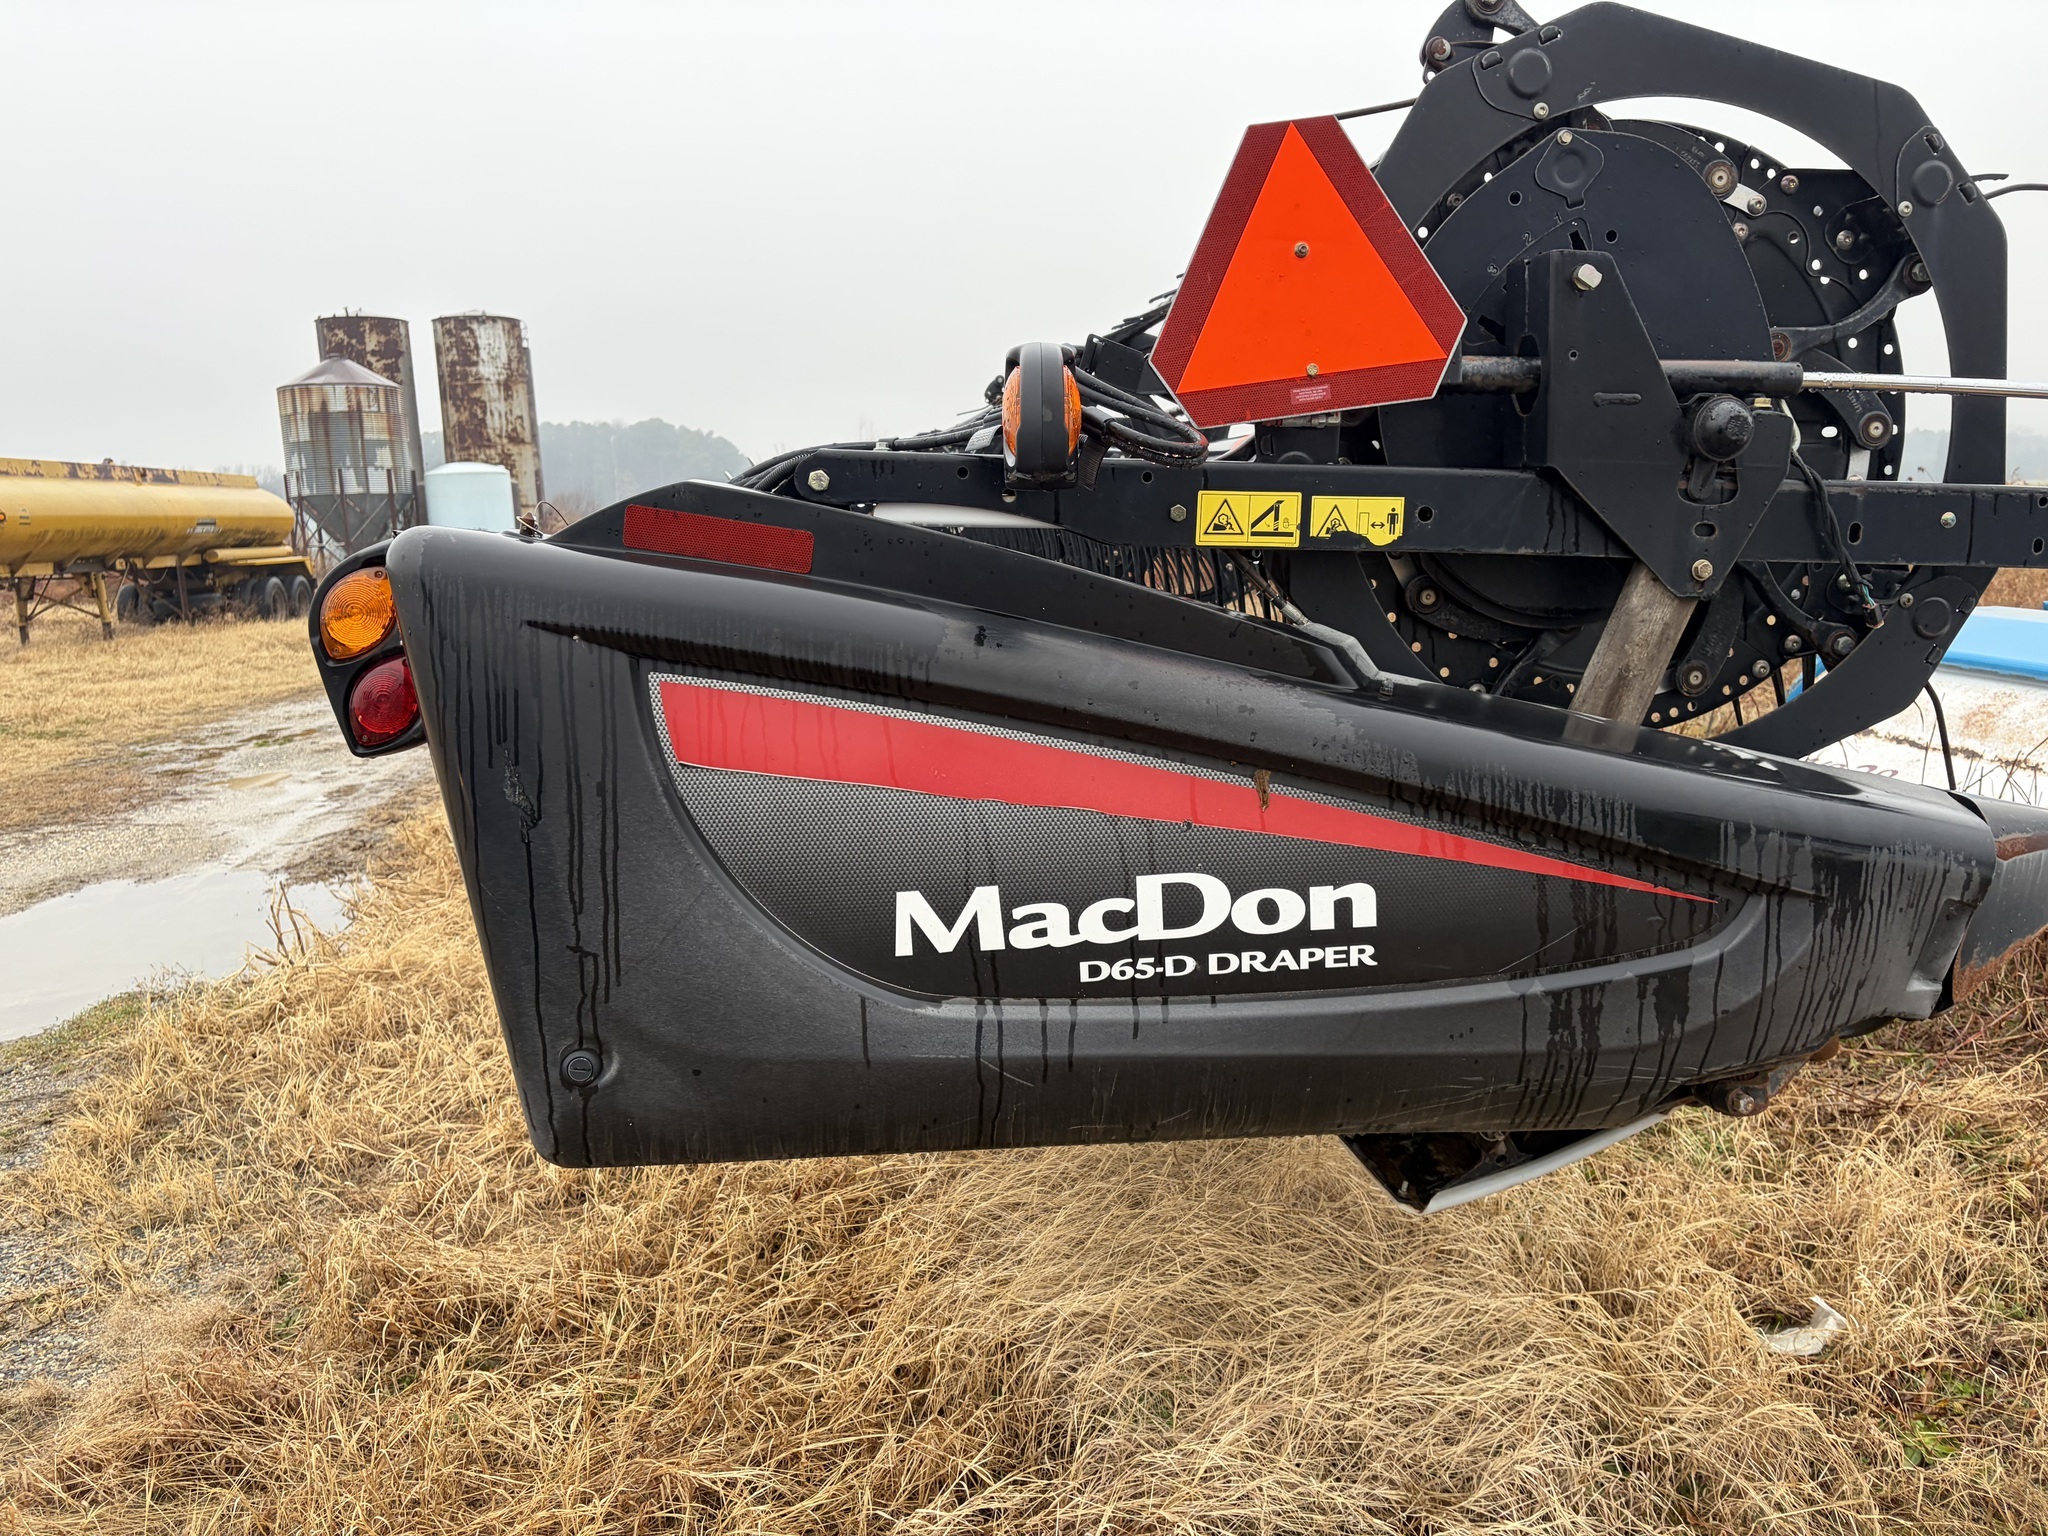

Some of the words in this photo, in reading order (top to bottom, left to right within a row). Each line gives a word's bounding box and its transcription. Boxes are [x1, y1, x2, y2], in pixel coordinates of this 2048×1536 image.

[1554, 211, 1563, 225] 1
[1521, 231, 1536, 247] 2
[1487, 262, 1500, 276] 3
[895, 872, 1378, 957] MacDon
[1079, 956, 1197, 982] D65-D
[1208, 944, 1378, 975] DRAPER
